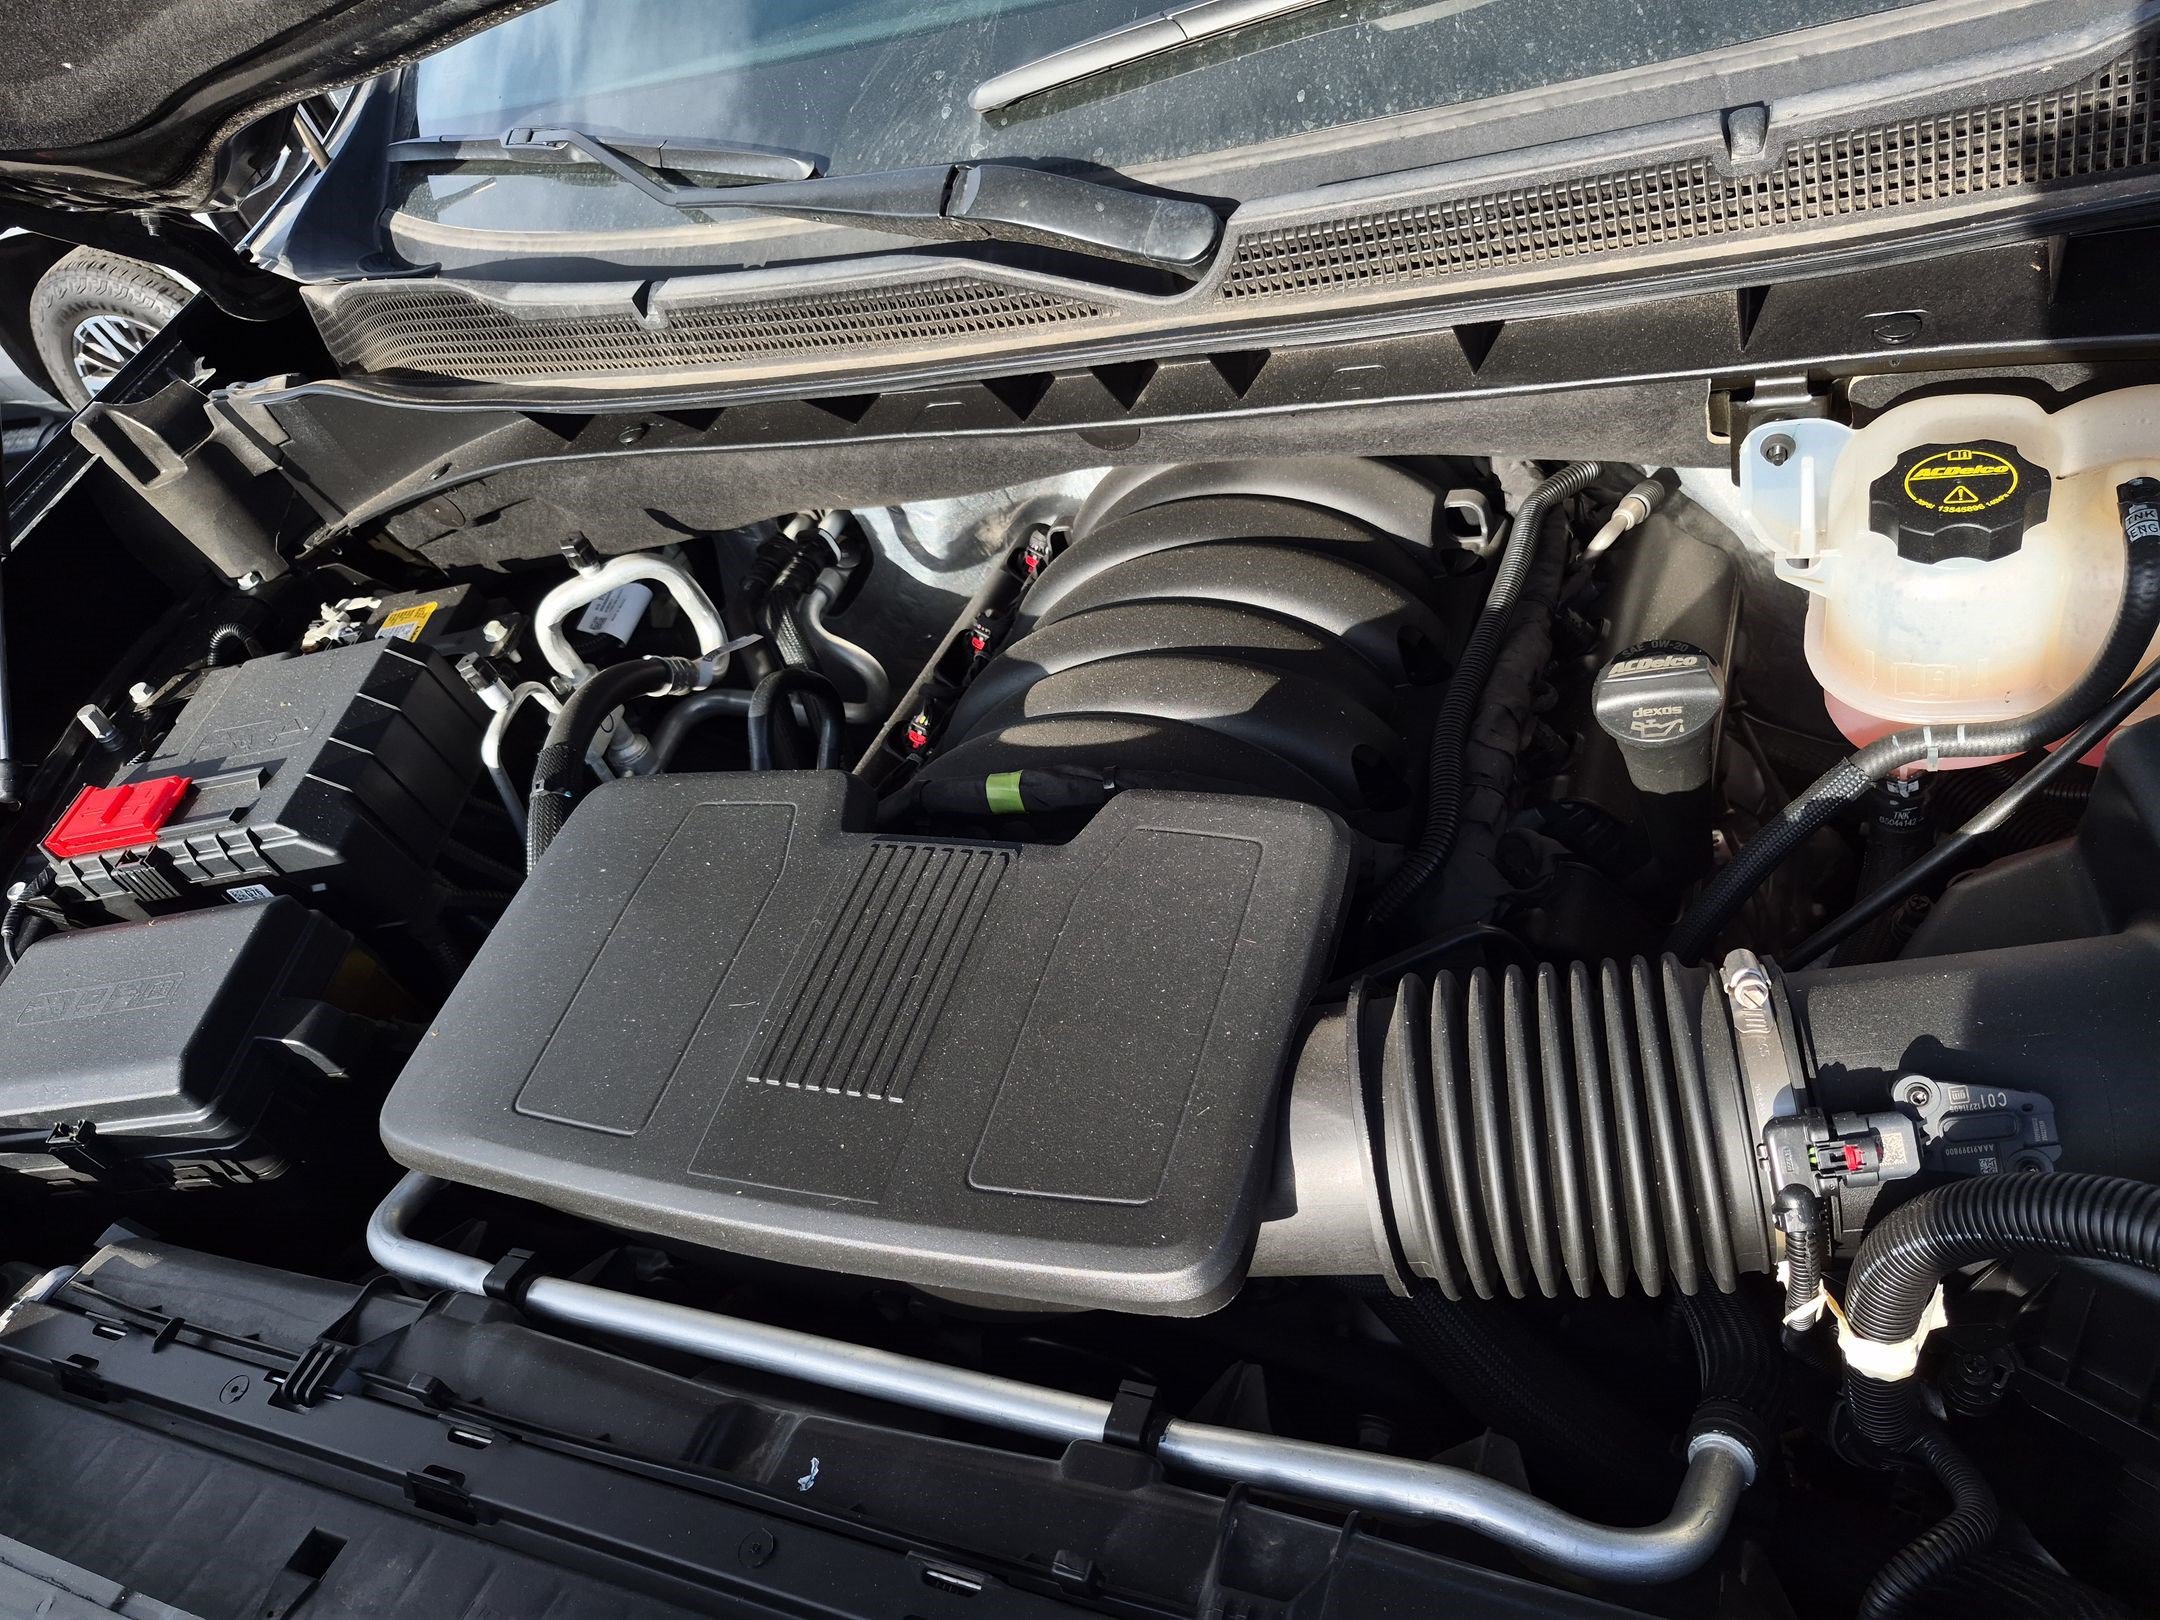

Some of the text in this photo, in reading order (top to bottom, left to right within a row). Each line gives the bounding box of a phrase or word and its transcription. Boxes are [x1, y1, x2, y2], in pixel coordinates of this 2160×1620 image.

[1912, 465, 2010, 479] ACDelco
[2126, 509, 2156, 525] TNK
[2130, 523, 2158, 538] ENG
[1622, 640, 1689, 657] SAE 0W-20
[1608, 656, 1698, 675] ACDelco
[1632, 705, 1684, 718] dexos
[1979, 1092, 2007, 1109] C01
